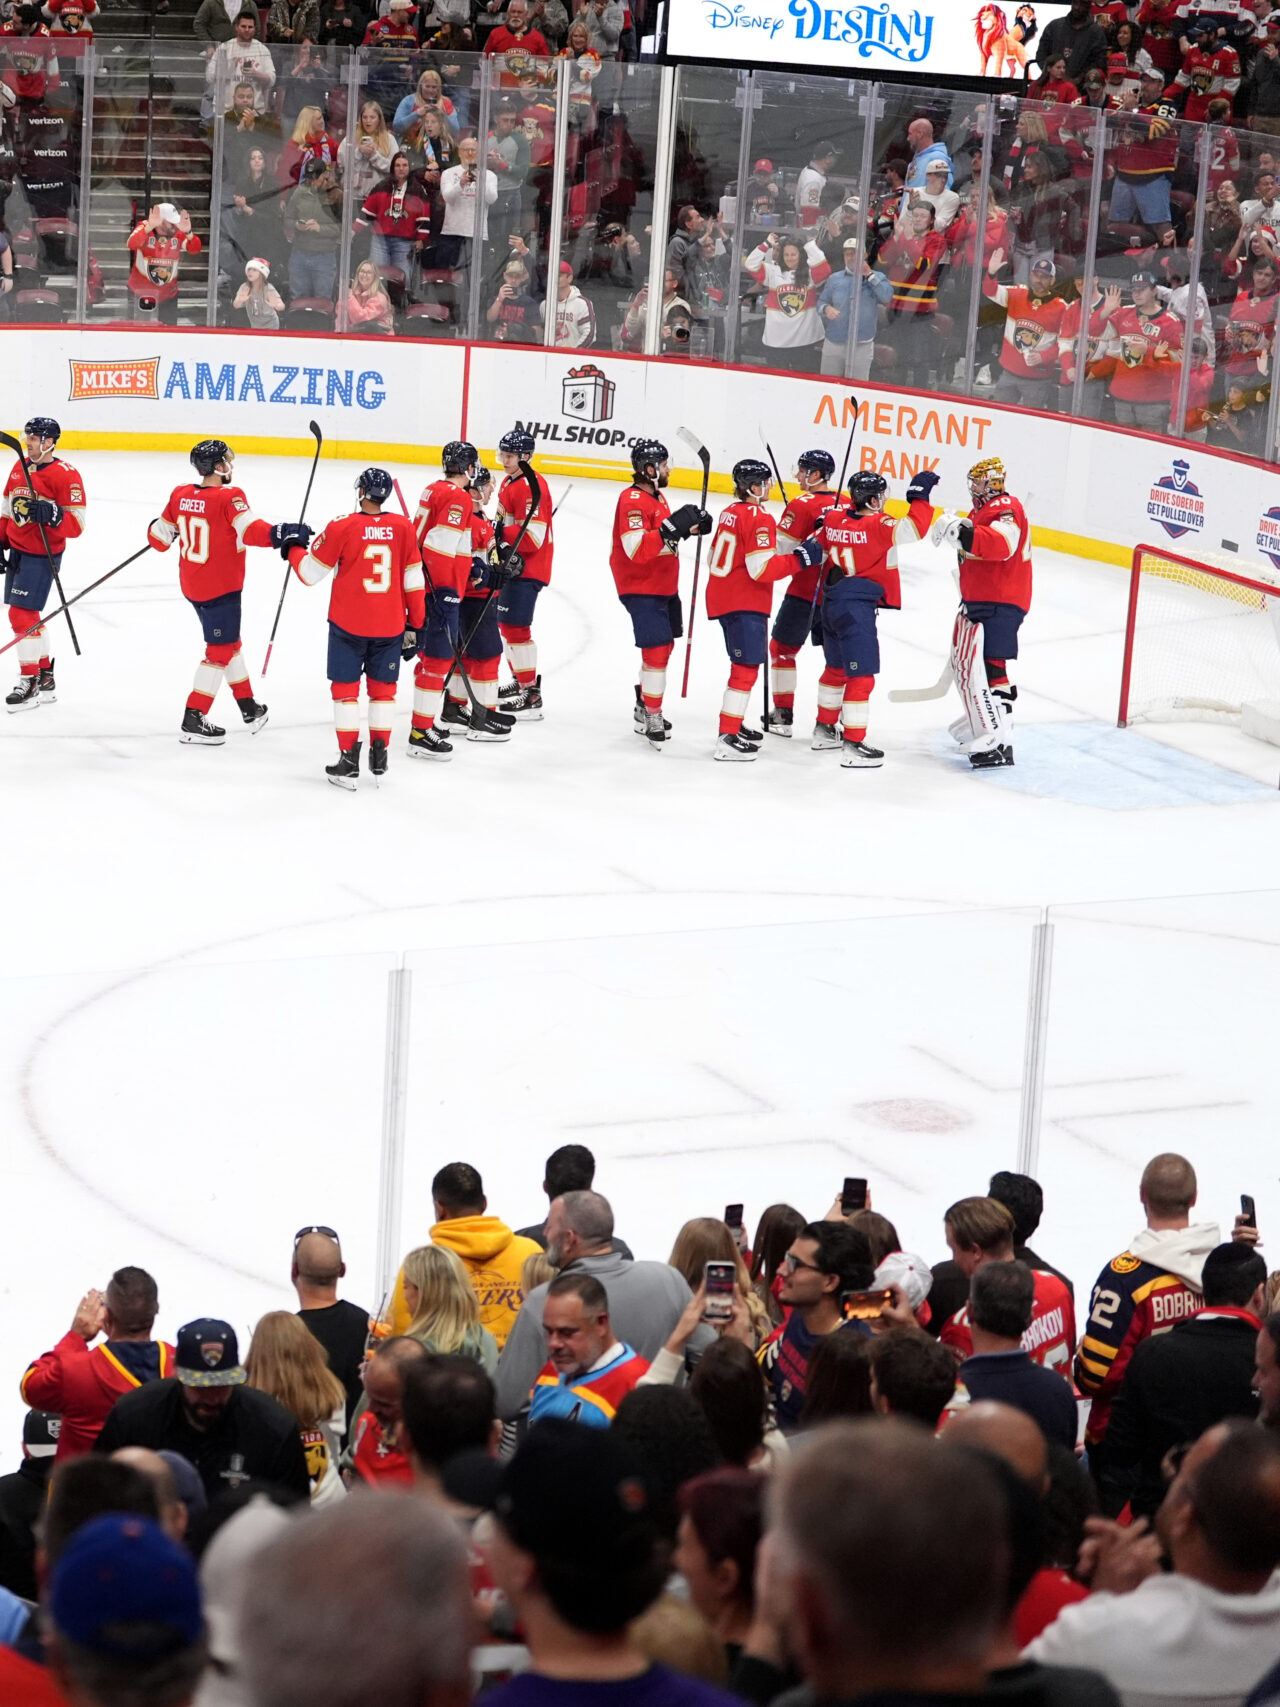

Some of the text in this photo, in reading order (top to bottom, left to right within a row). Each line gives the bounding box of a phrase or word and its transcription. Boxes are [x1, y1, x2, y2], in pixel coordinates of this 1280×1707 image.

[29, 116, 64, 126] verizon
[33, 149, 67, 158] verizon
[81, 369, 148, 389] MIKE'S
[164, 361, 386, 410] AMAZING
[814, 395, 992, 450] AMERANT
[860, 446, 940, 480] BANK
[179, 498, 205, 514] GREER
[630, 491, 641, 499] 5
[989, 497, 1012, 508] 40
[1150, 489, 1205, 514] DRIVE SOBER OR
[719, 511, 738, 528] VIST
[1147, 502, 1205, 528] GET PULLED OVER
[1259, 519, 1278, 535] DRIVE
[176, 515, 210, 564] 10
[362, 527, 394, 540] JONES
[1256, 533, 1280, 551] GET PUL
[708, 529, 738, 578] 0
[363, 544, 393, 594] 3
[982, 688, 998, 731] VAUGHN
[475, 1287, 525, 1312] KERS
[1019, 1306, 1064, 1353] BARKOV
